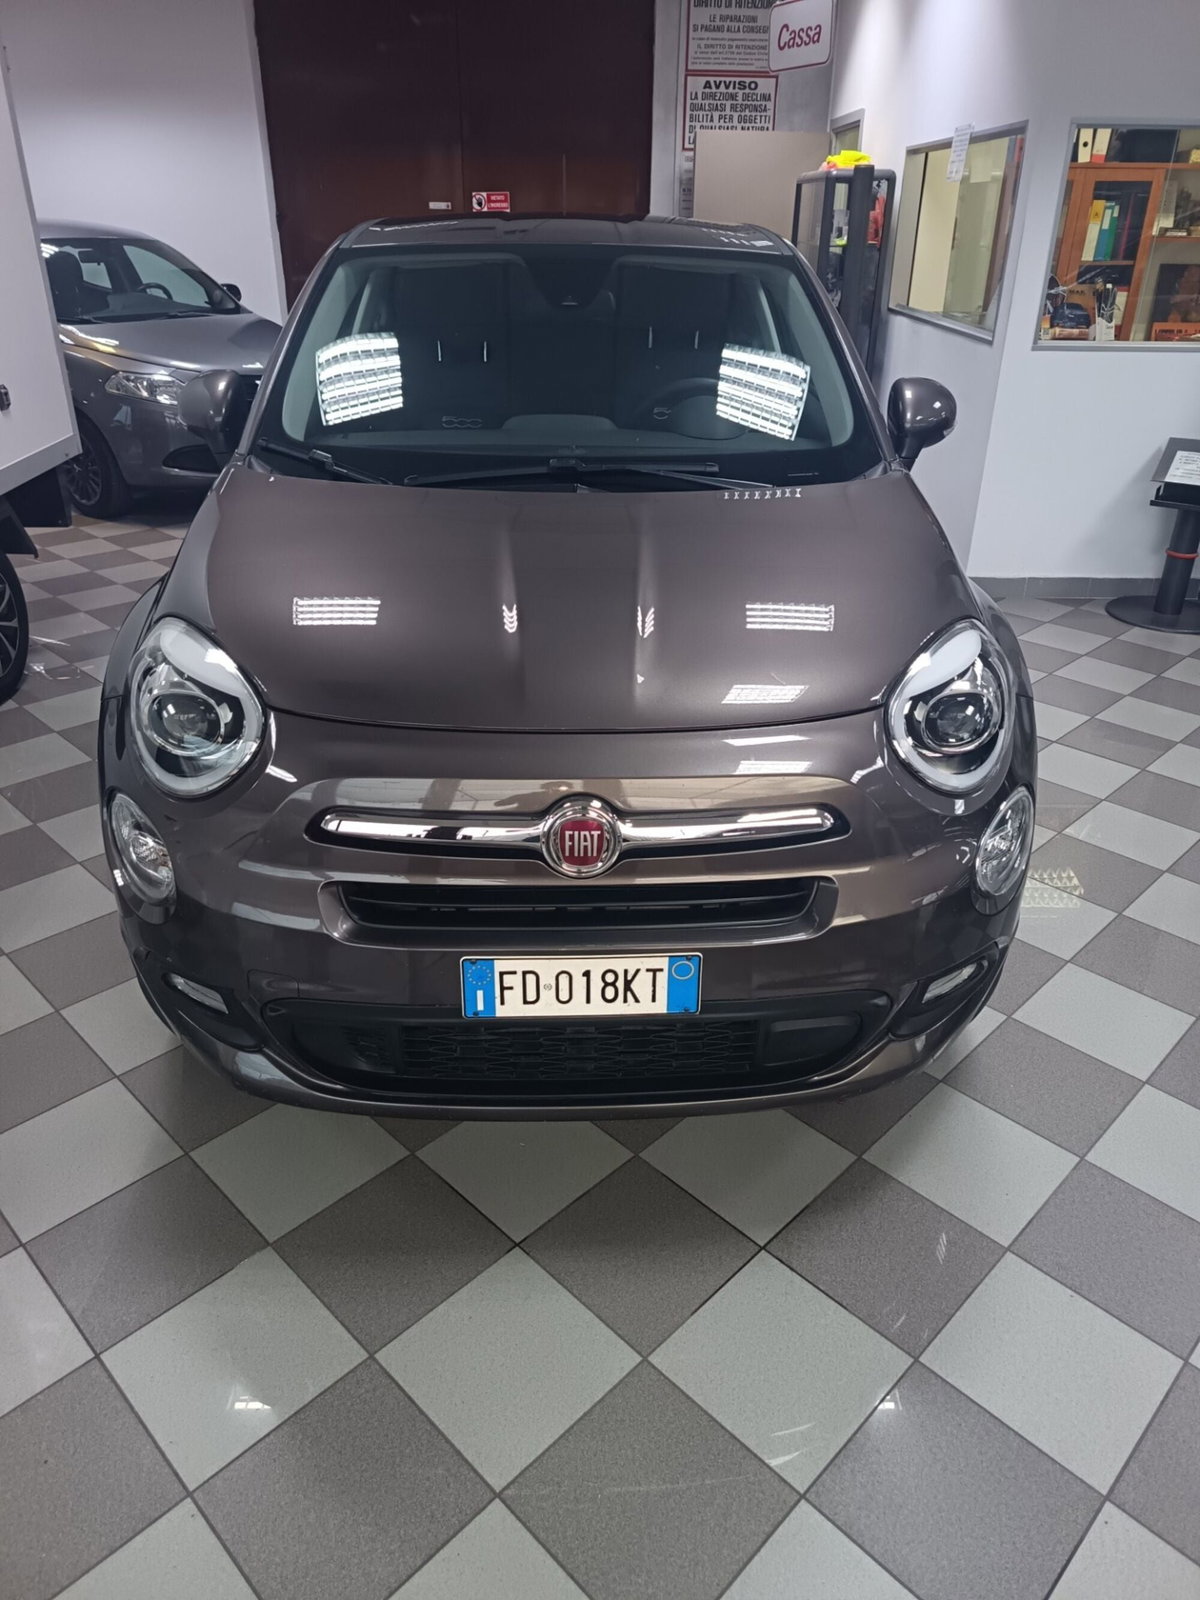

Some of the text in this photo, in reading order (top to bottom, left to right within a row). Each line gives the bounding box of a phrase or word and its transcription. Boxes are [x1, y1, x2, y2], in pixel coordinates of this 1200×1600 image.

[709, 14, 758, 23] LE RIPARAZIONI
[692, 24, 699, 32] SI
[700, 24, 725, 32] PAGANO
[726, 25, 741, 33] ALLA
[778, 23, 822, 51] Cassa
[703, 80, 759, 90] AVVISO
[690, 91, 771, 102] LA DIREZIONE DECLINA
[690, 102, 771, 113] QUALSIASI RESPONSA-
[689, 112, 771, 124] BILITÀ PER OGGETTI
[565, 830, 601, 857] FIAT
